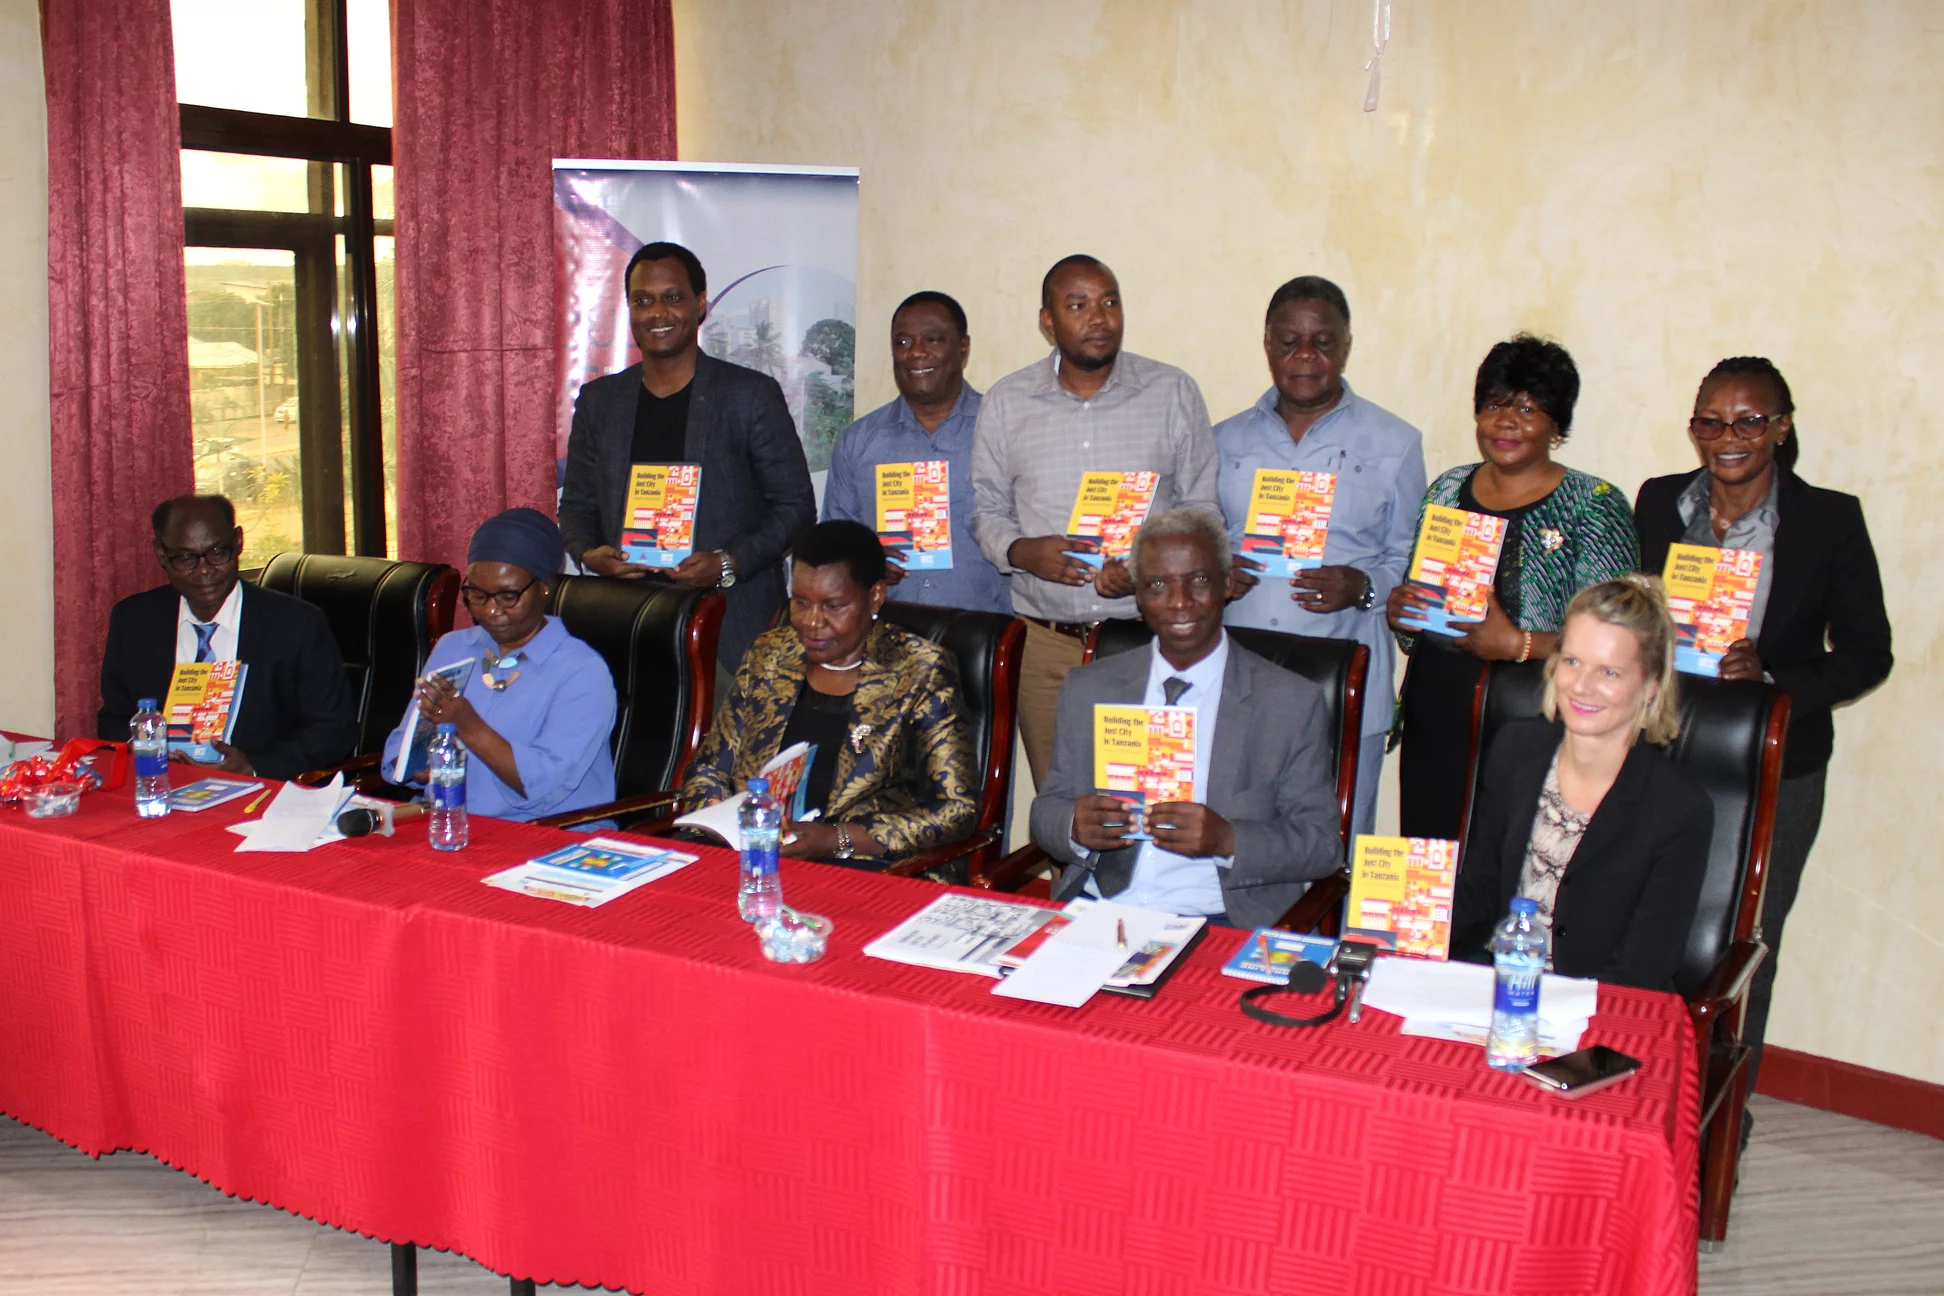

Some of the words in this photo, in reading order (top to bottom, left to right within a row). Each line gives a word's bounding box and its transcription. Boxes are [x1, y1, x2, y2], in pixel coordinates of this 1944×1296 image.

[1262, 476, 1284, 484] Building
[1677, 554, 1703, 563] Building
[1688, 564, 1701, 573] City
[1680, 574, 1707, 583] Tanzania
[1104, 716, 1131, 726] Building
[1119, 728, 1132, 737] City
[1112, 738, 1141, 747] Tanzania
[1365, 847, 1391, 857] Building
[1379, 860, 1391, 869] City
[1370, 872, 1400, 880] Tanzania
